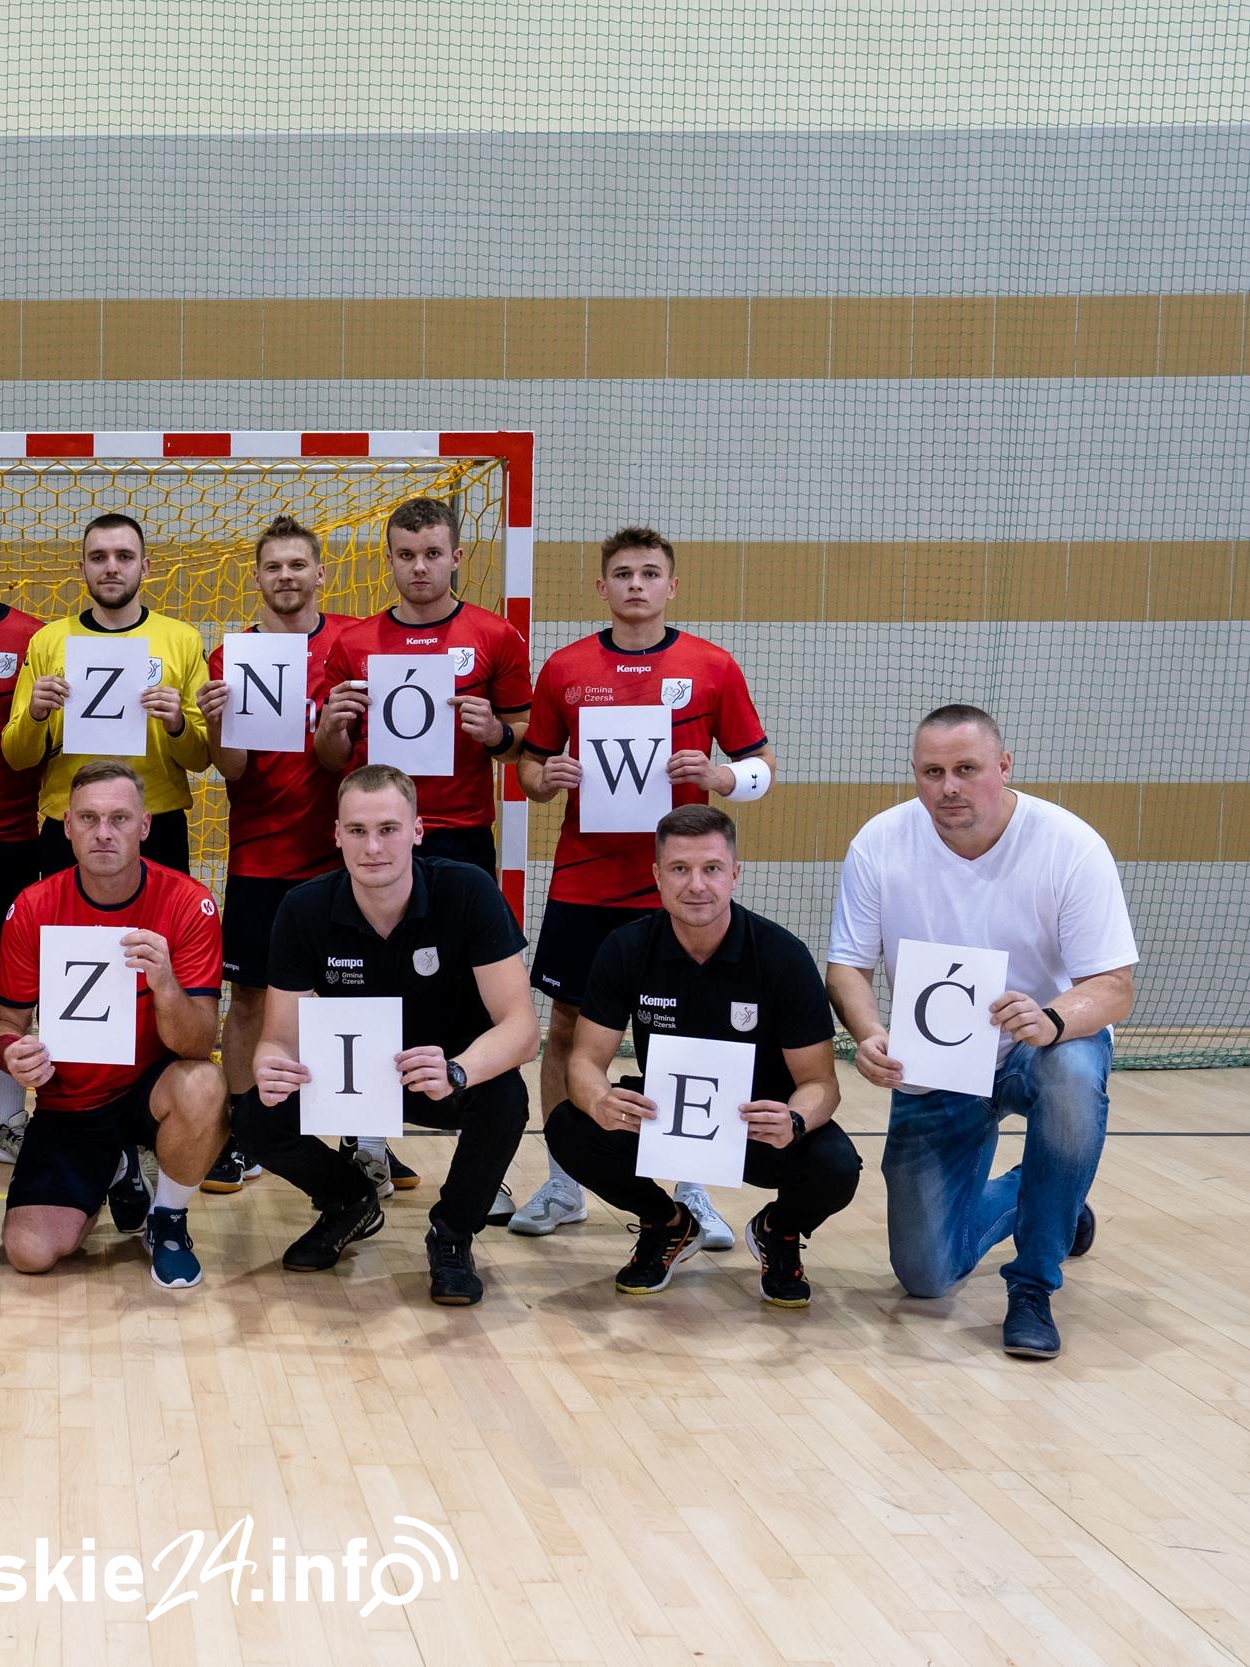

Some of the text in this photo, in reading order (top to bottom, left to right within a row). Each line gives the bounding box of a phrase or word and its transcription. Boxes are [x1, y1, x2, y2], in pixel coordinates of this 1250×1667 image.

[406, 637, 438, 646] Kempa
[616, 664, 652, 675] Kempa
[80, 666, 125, 720] Z
[233, 663, 291, 717] N
[584, 685, 613, 694] Gmina
[584, 693, 615, 702] Czersk
[382, 668, 436, 740] Ó
[586, 738, 666, 796] W
[327, 956, 364, 970] Kempa
[342, 971, 364, 979] Gmina
[58, 960, 111, 1022] Z
[639, 994, 677, 1010] Kempa
[914, 962, 975, 1047] Ć
[653, 1013, 676, 1022] Gmina
[653, 1020, 677, 1029] Czersk
[334, 1033, 363, 1095] I
[662, 1072, 720, 1141] E
